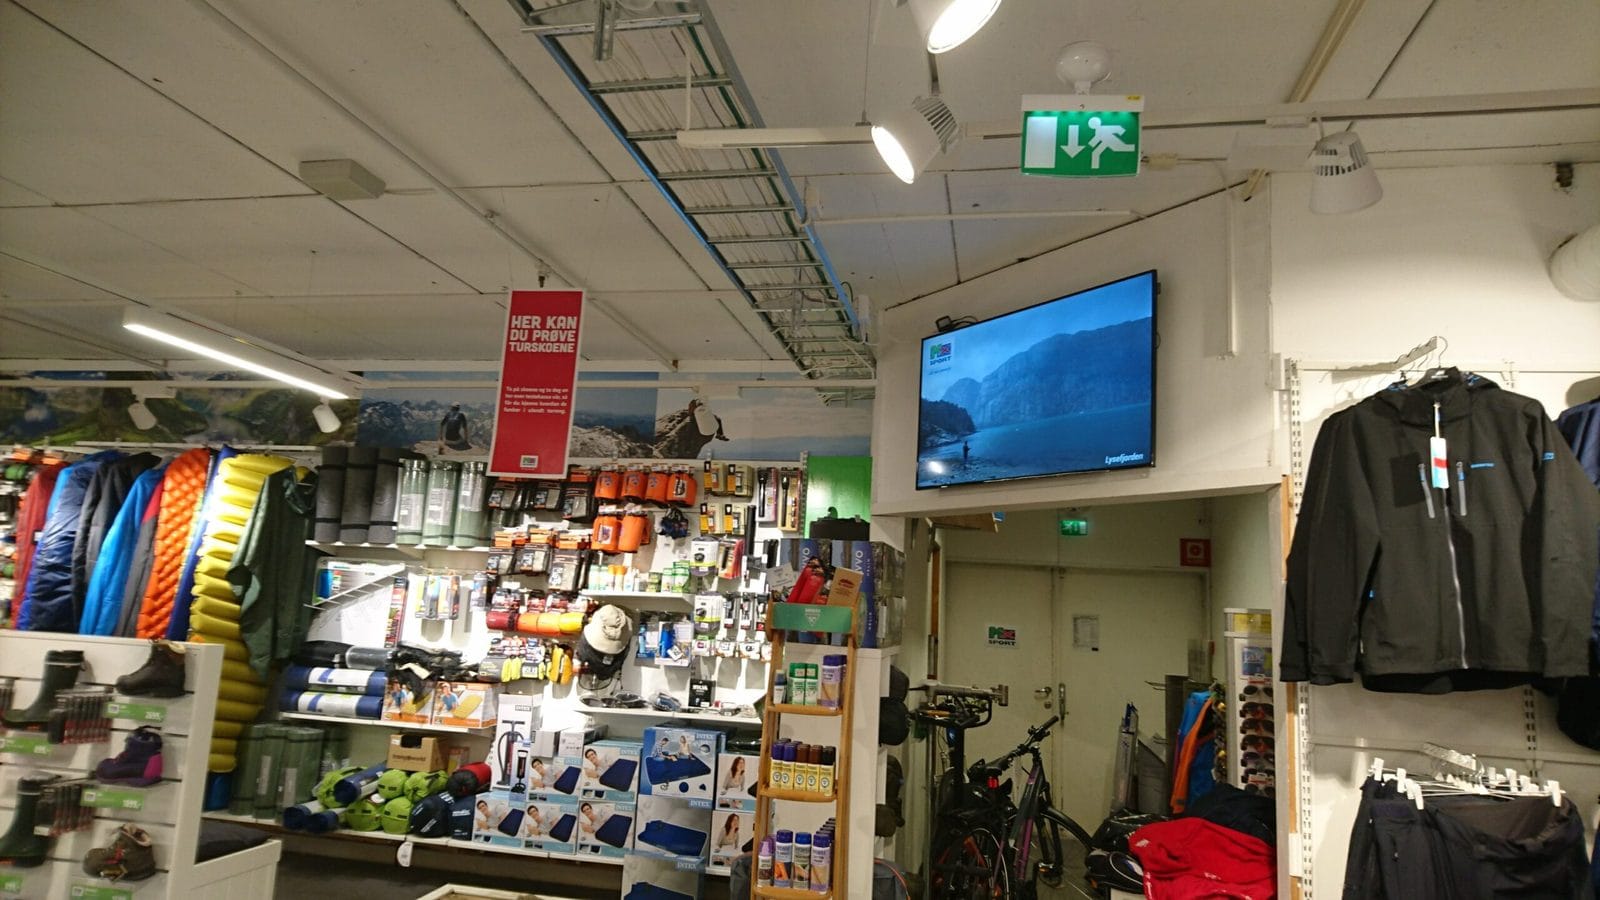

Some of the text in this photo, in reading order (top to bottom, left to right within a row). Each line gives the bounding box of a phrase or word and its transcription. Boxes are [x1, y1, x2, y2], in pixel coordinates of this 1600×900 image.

[511, 315, 577, 329] HER KAN
[510, 329, 576, 342] DU PRØVE
[509, 342, 575, 353] TURSKOENE
[1105, 452, 1144, 465] Lysefjorden
